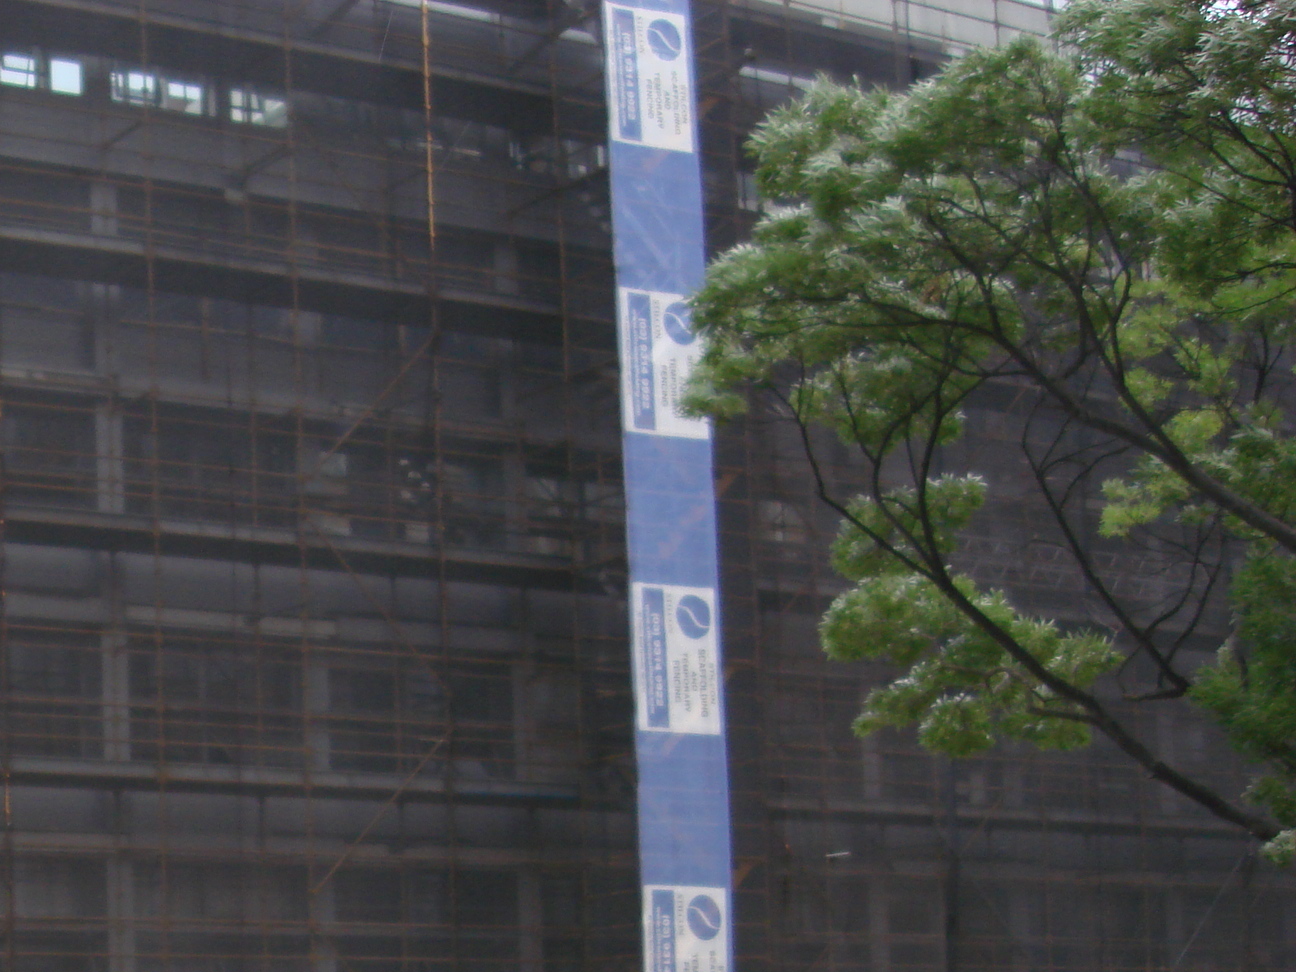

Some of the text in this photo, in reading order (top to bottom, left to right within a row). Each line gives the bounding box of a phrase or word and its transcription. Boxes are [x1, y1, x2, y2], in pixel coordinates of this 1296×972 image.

[646, 79, 654, 118] FENCING
[654, 72, 664, 129] TEMPORARY
[661, 365, 669, 407] FENCING
[673, 660, 681, 703] FENCING
[682, 653, 691, 712] TEMPORARY
[698, 649, 709, 717] SCAFFOLDING
